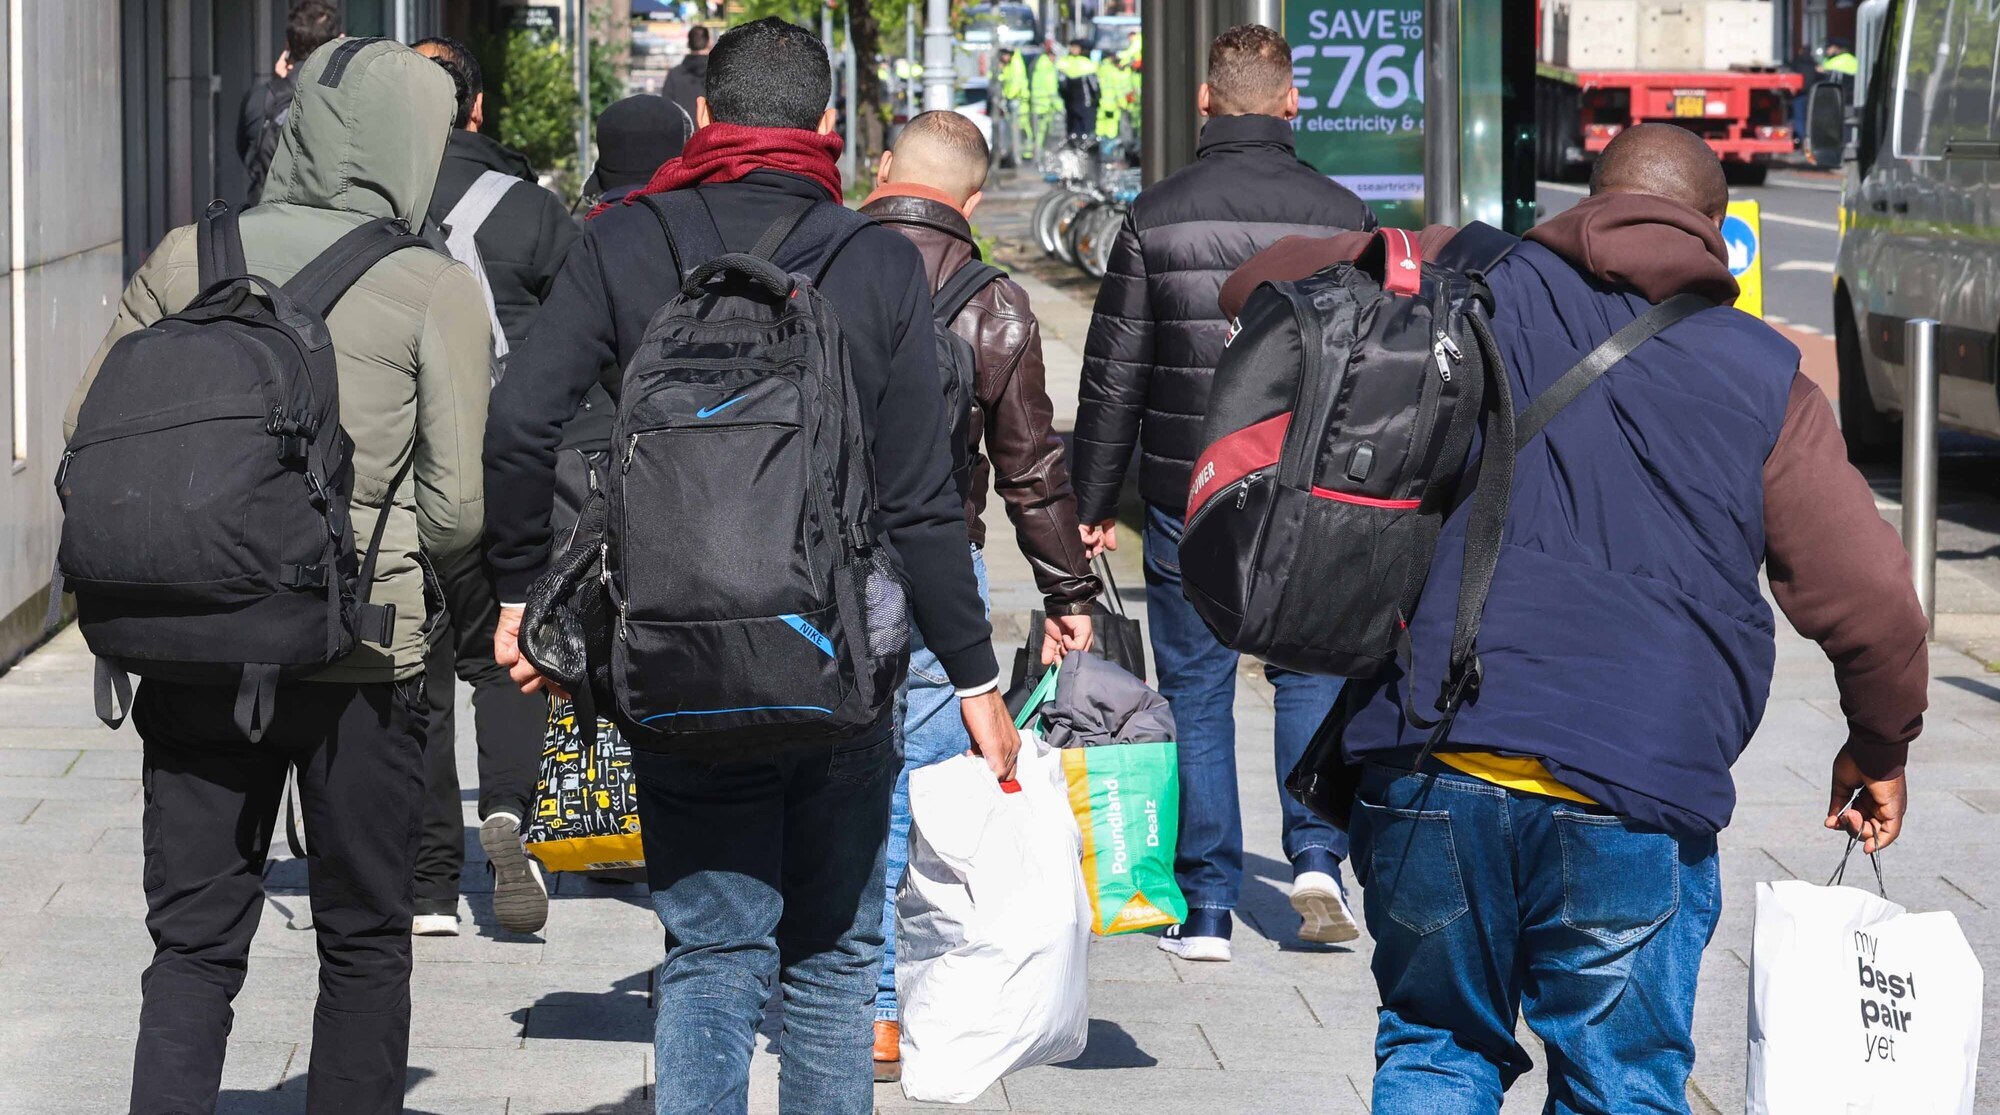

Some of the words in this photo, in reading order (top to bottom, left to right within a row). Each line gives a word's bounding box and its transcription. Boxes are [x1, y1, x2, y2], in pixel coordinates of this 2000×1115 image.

[1308, 9, 1396, 40] SAVE
[1400, 11, 1422, 24] UP
[1400, 25, 1422, 40] TO
[1291, 44, 1424, 110] €76
[1307, 114, 1397, 135] electricity
[1402, 114, 1415, 131] &
[799, 622, 824, 646] NIKE
[1103, 778, 1128, 875] Poundland
[1144, 799, 1160, 848] Dealz
[1854, 929, 1878, 963] my
[1858, 956, 1916, 1000] best
[1861, 998, 1912, 1033] pair
[1864, 1033, 1895, 1062] yet
